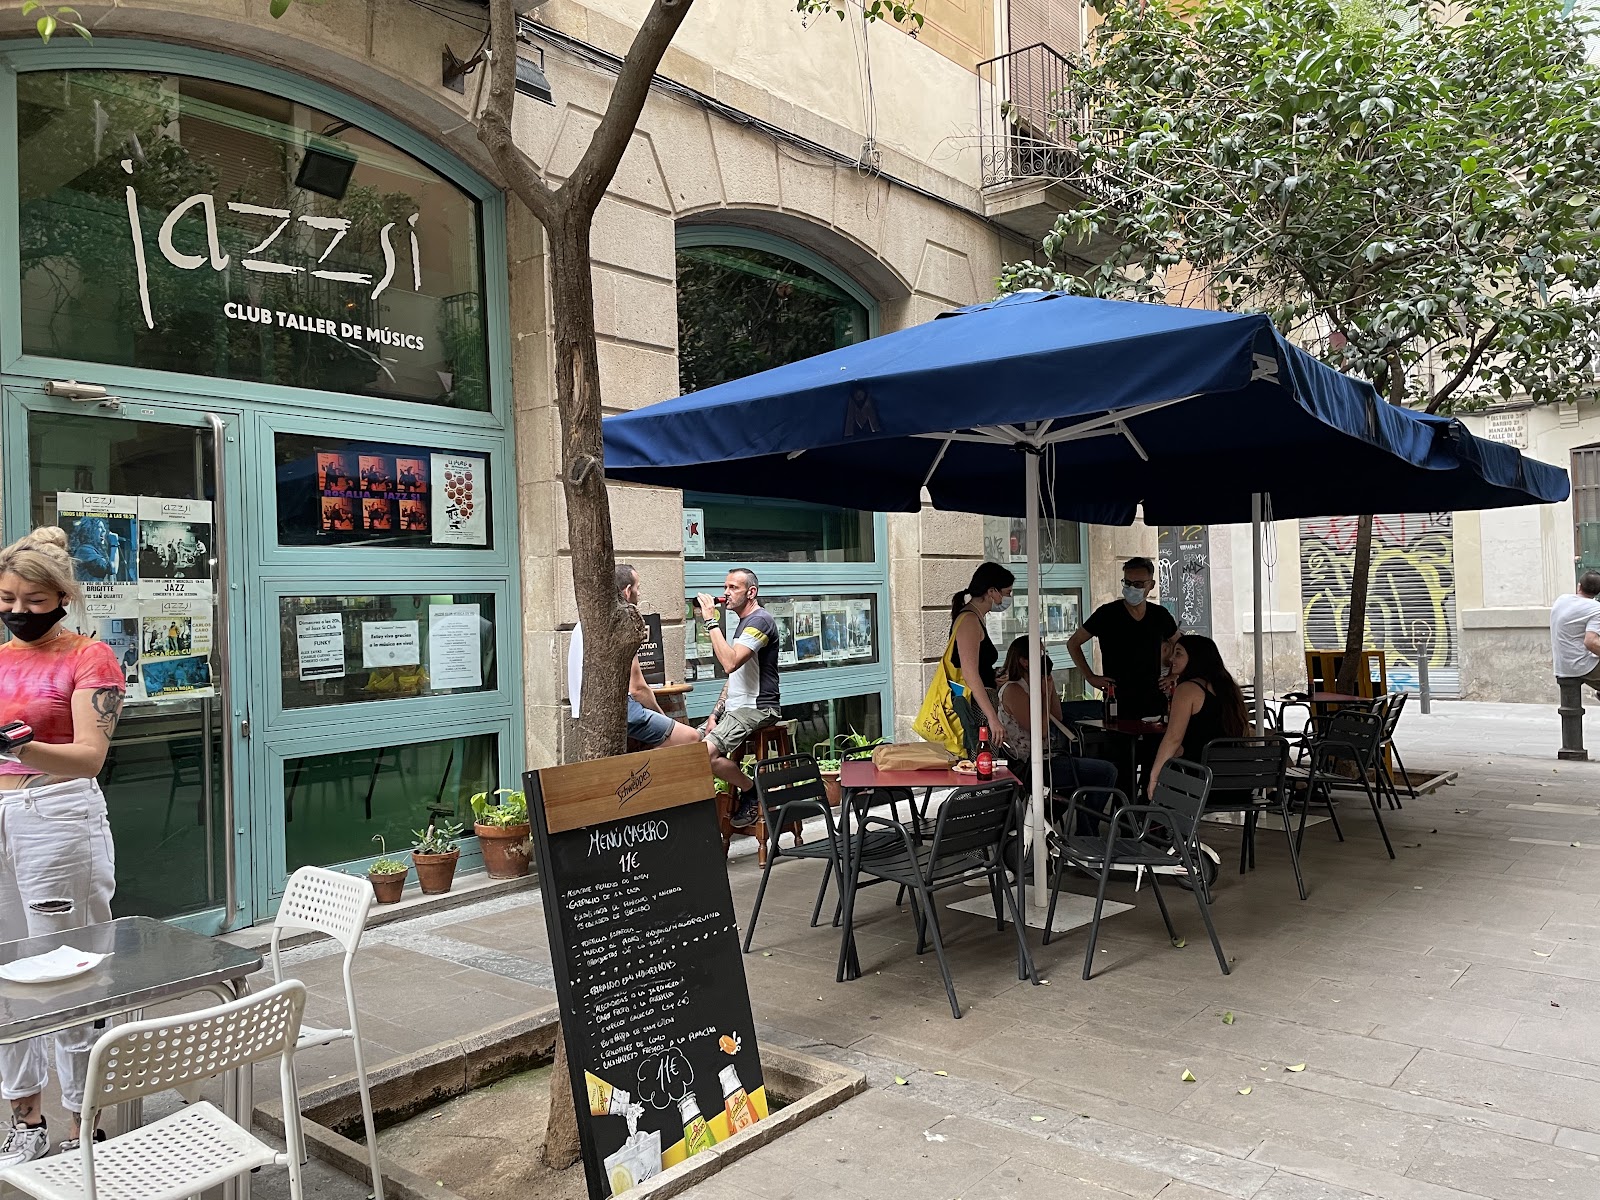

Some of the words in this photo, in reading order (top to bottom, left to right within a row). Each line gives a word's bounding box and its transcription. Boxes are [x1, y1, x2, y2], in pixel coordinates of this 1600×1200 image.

[223, 302, 272, 324] CLUB
[276, 311, 337, 336] TALLER
[341, 323, 362, 340] DE
[366, 327, 424, 350] MÚSICS
[384, 492, 408, 500] JAZZ
[164, 584, 185, 592] JAZZ
[617, 768, 651, 803] Schweppes
[587, 826, 622, 857] MENÚ
[623, 820, 669, 847] CASERO
[618, 851, 641, 872] 11€
[655, 1054, 680, 1093] 11€
